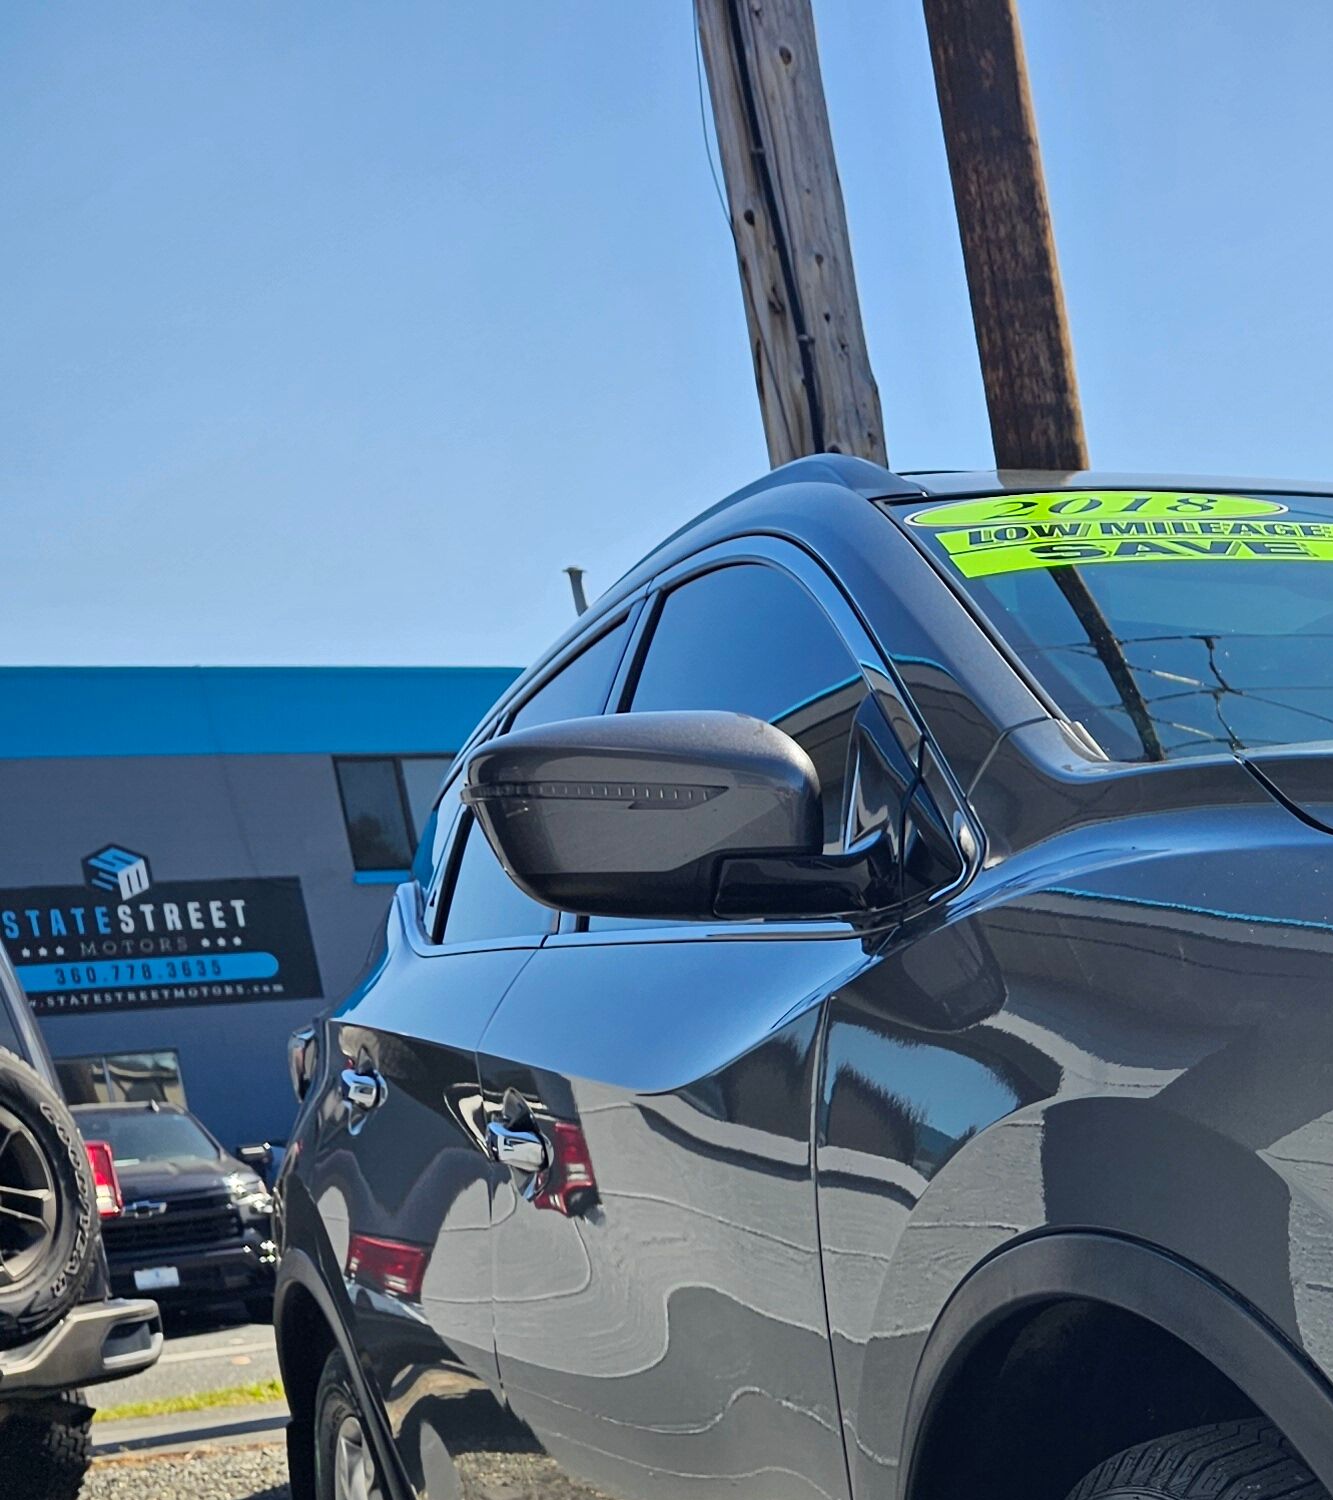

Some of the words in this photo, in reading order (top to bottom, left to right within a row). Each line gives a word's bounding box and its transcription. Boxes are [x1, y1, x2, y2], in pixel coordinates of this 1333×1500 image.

[989, 496, 1220, 520] 2018
[967, 523, 1086, 544] LOW
[1028, 540, 1320, 561] SAVE
[80, 936, 189, 958] MOTORS
